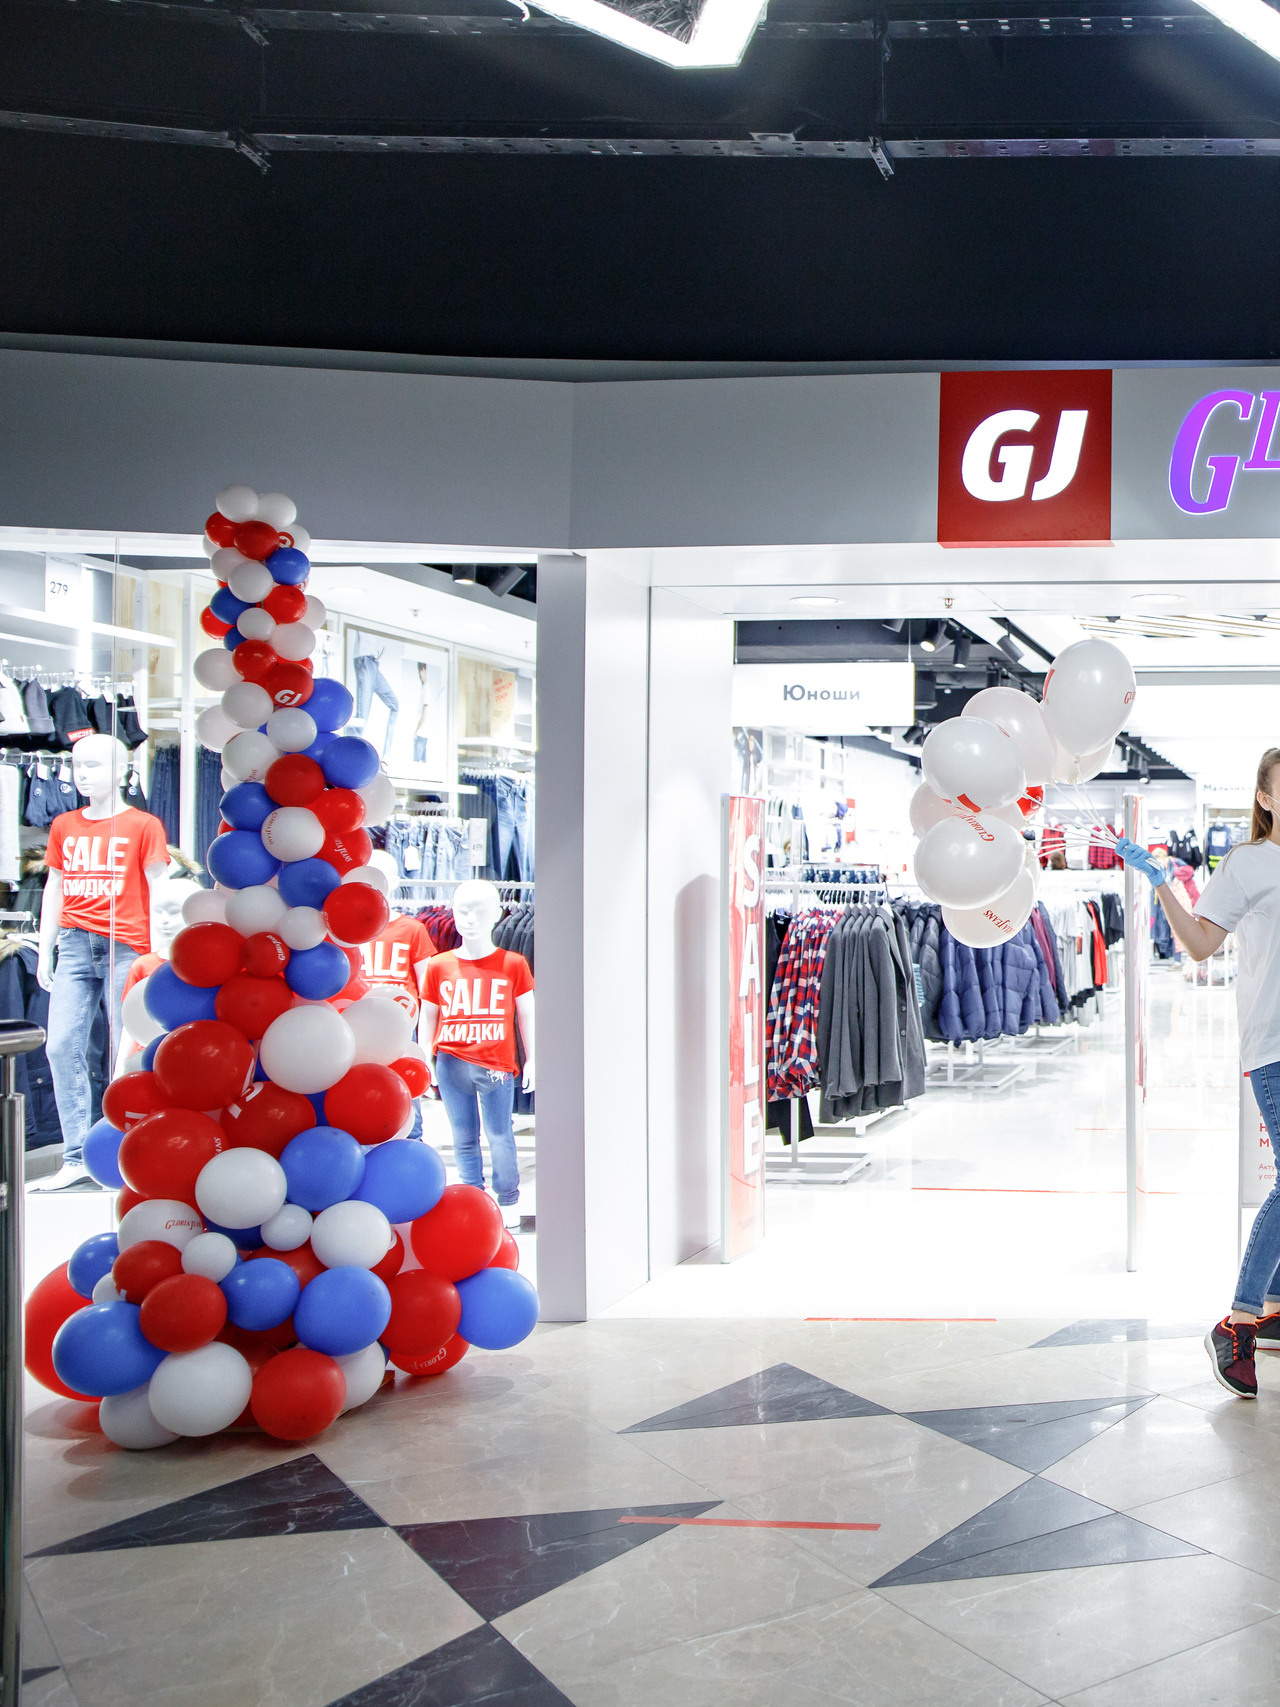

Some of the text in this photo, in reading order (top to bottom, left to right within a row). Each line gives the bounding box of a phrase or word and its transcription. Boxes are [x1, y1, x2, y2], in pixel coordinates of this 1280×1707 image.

[960, 409, 1089, 502] GJ
[49, 580, 69, 596] 279
[274, 689, 303, 706] GJ
[783, 684, 860, 701] Юноши
[62, 836, 129, 873] SALE
[983, 908, 1010, 929] JEANS
[358, 941, 410, 978] ALE
[439, 978, 508, 1018] SALE
[739, 833, 761, 1177] SALE
[165, 1219, 191, 1230] GLORIA
[418, 1347, 448, 1369] GLORIA
